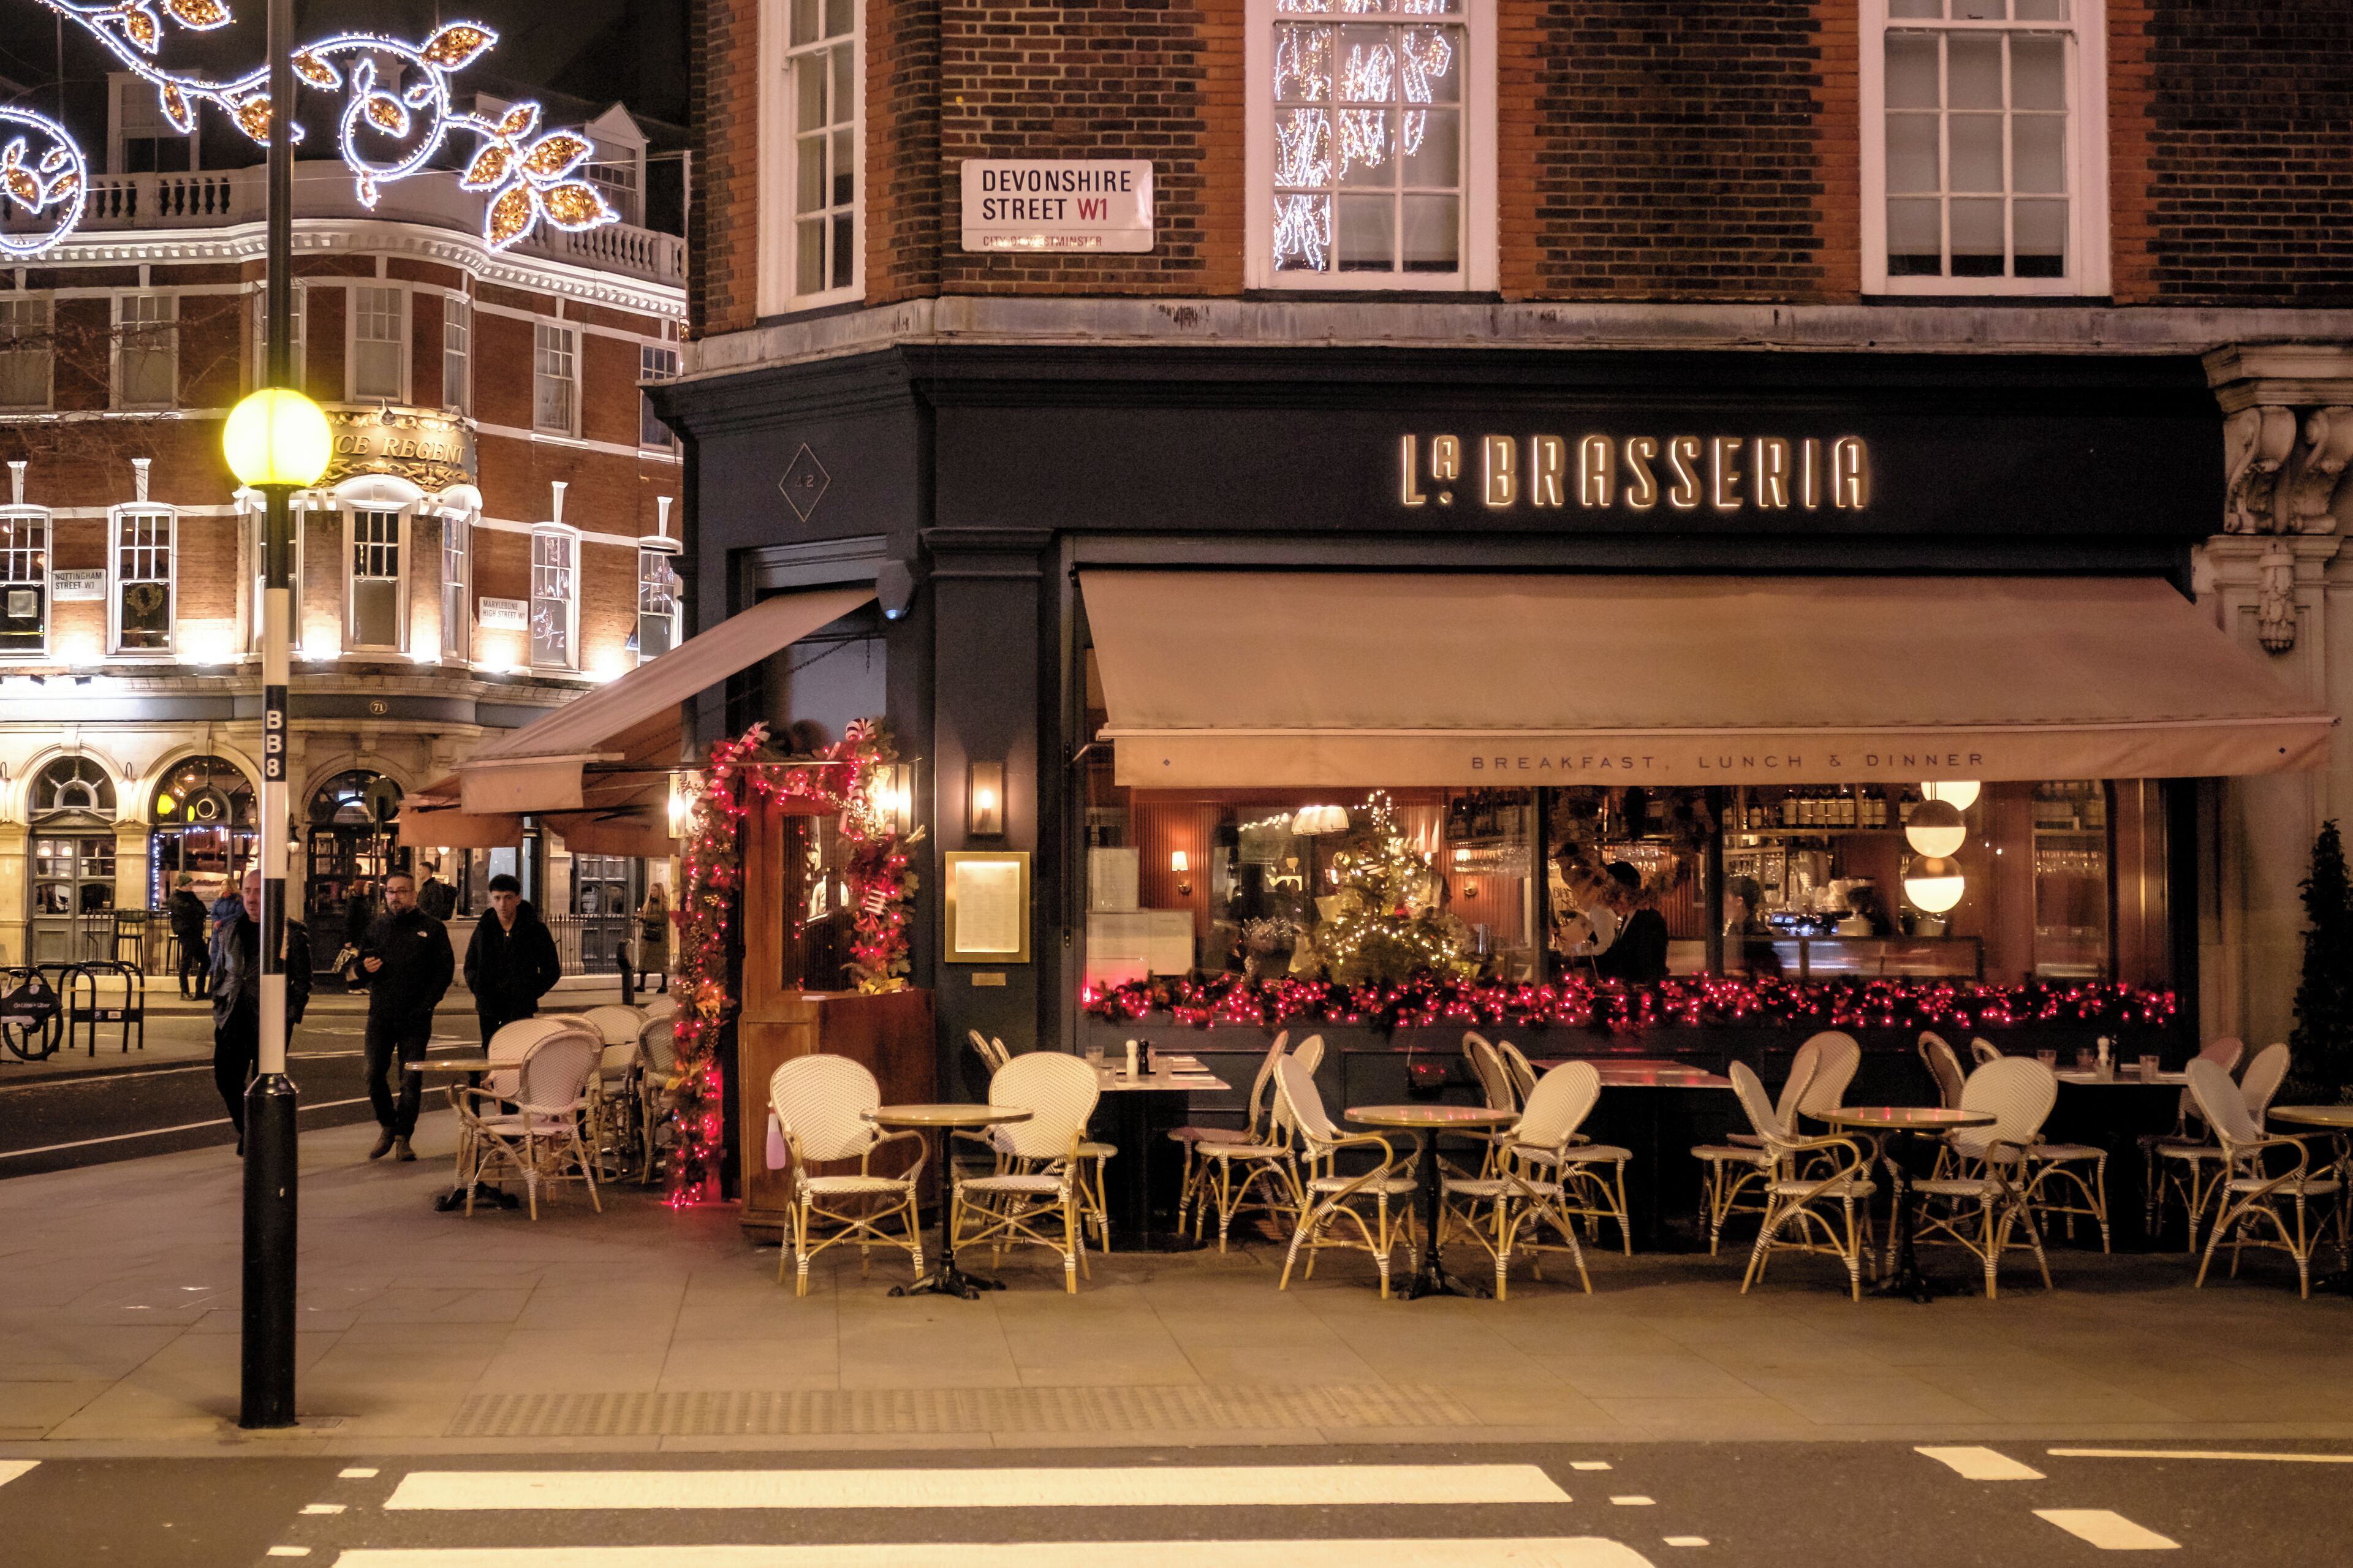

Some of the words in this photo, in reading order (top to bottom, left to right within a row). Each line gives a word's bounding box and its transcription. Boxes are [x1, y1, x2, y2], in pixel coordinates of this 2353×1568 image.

[982, 170, 1131, 192] DEVONSHIRE
[982, 197, 1067, 220] STREET
[1077, 197, 1107, 221] W1
[983, 236, 1006, 246] CITY
[380, 437, 465, 464] REGENT
[1485, 434, 1869, 506] BRASSERIA
[55, 572, 102, 580] NOTTINGHAM
[483, 600, 518, 610] MARYLEBONE
[498, 610, 516, 619] STREET
[374, 703, 384, 712] 71
[1472, 757, 1669, 771] BREAKFAST,
[1699, 755, 1802, 768] LUNCH
[1830, 754, 1841, 767] &
[1866, 754, 1982, 767] DINNER
